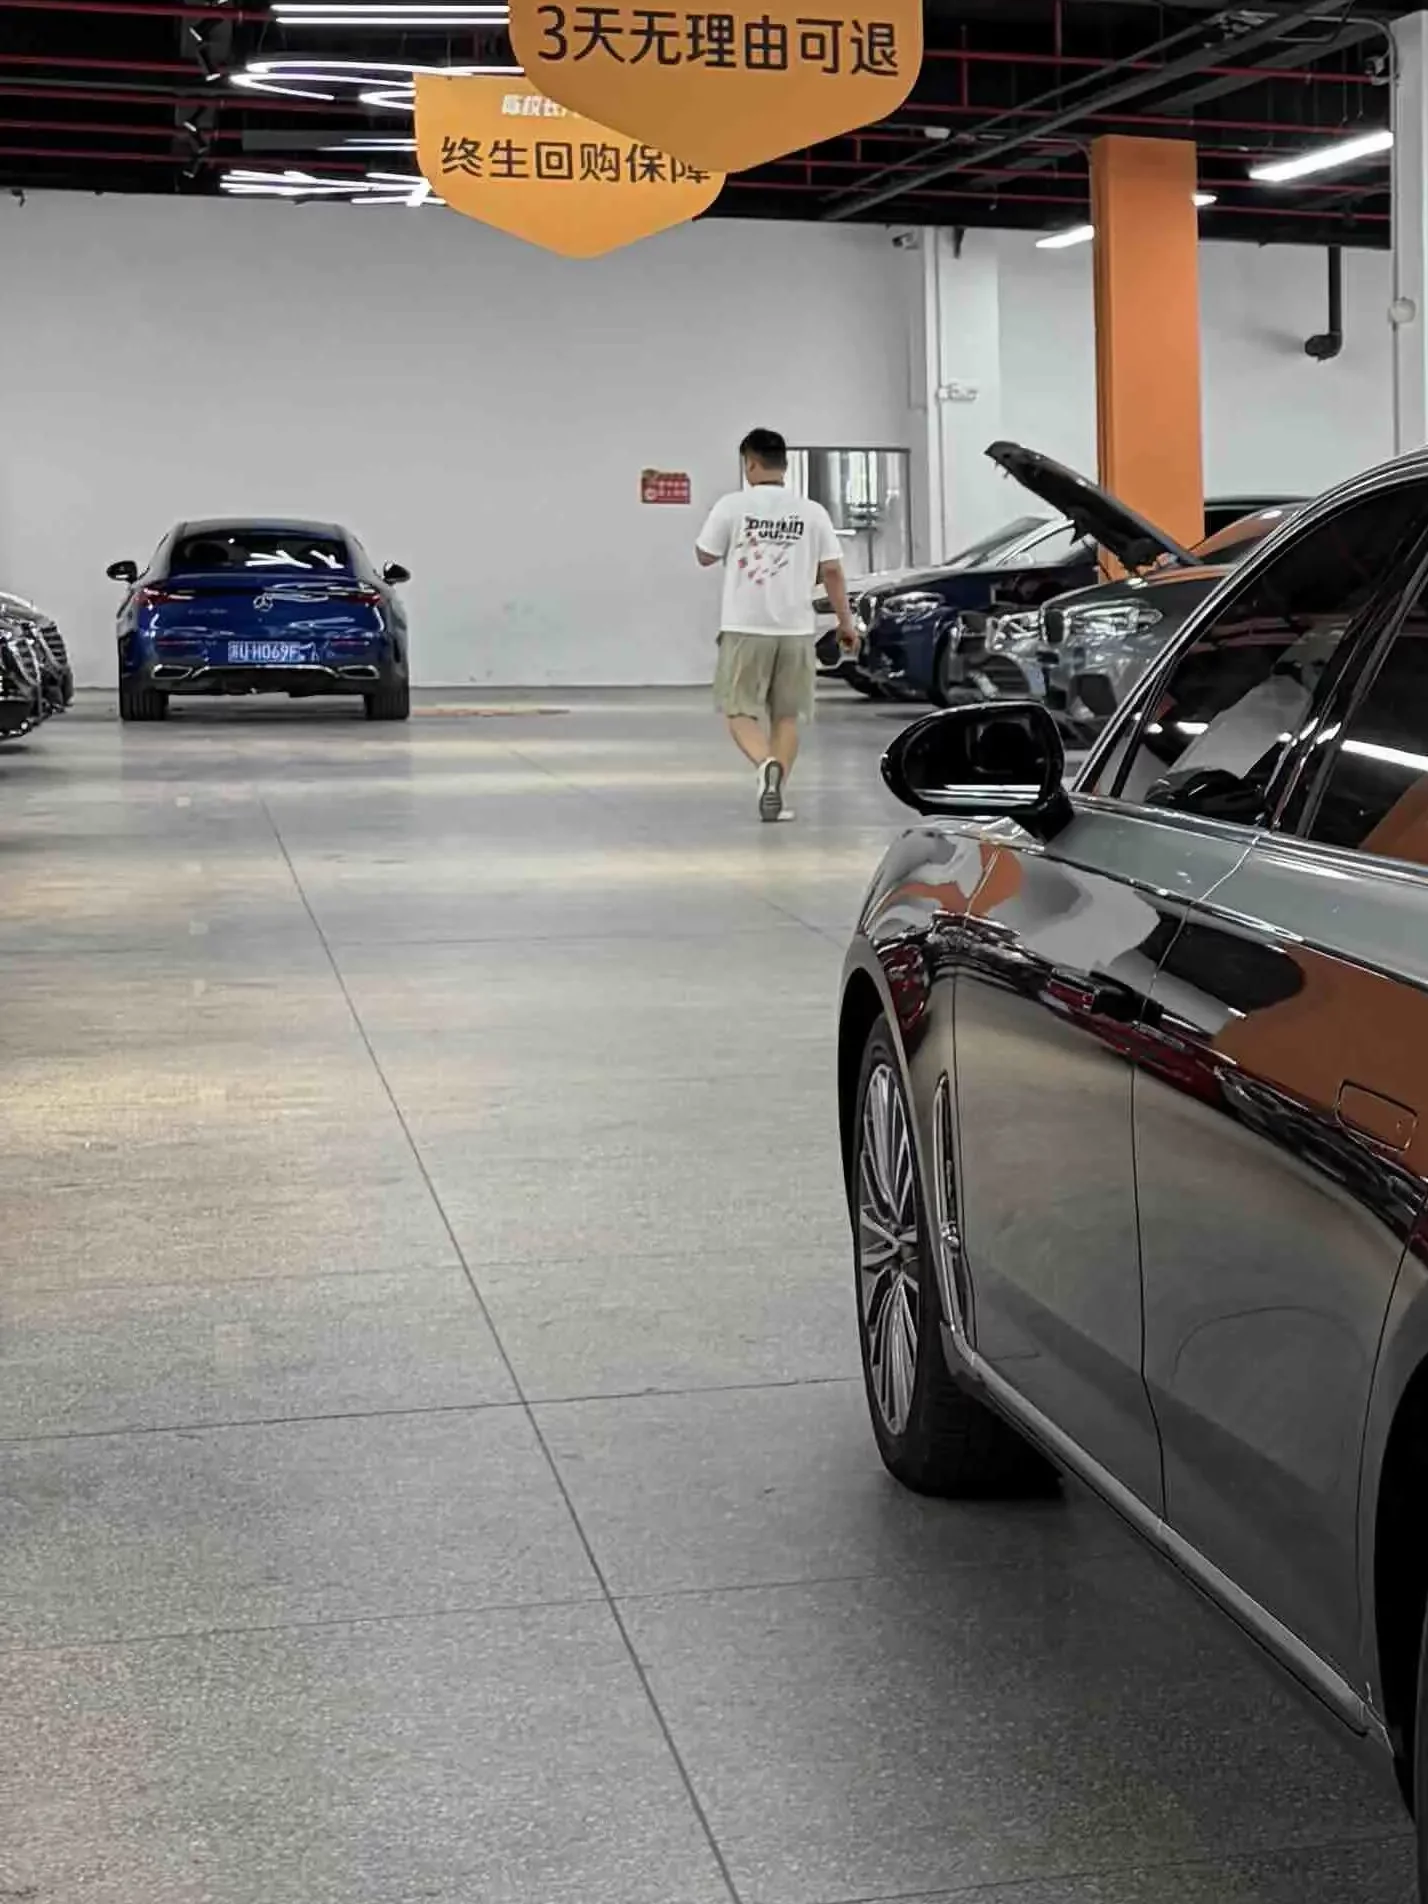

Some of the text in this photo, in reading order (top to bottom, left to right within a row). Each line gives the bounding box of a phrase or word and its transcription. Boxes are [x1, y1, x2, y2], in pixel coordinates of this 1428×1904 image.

[536, 4, 900, 77] 3天无理由可退
